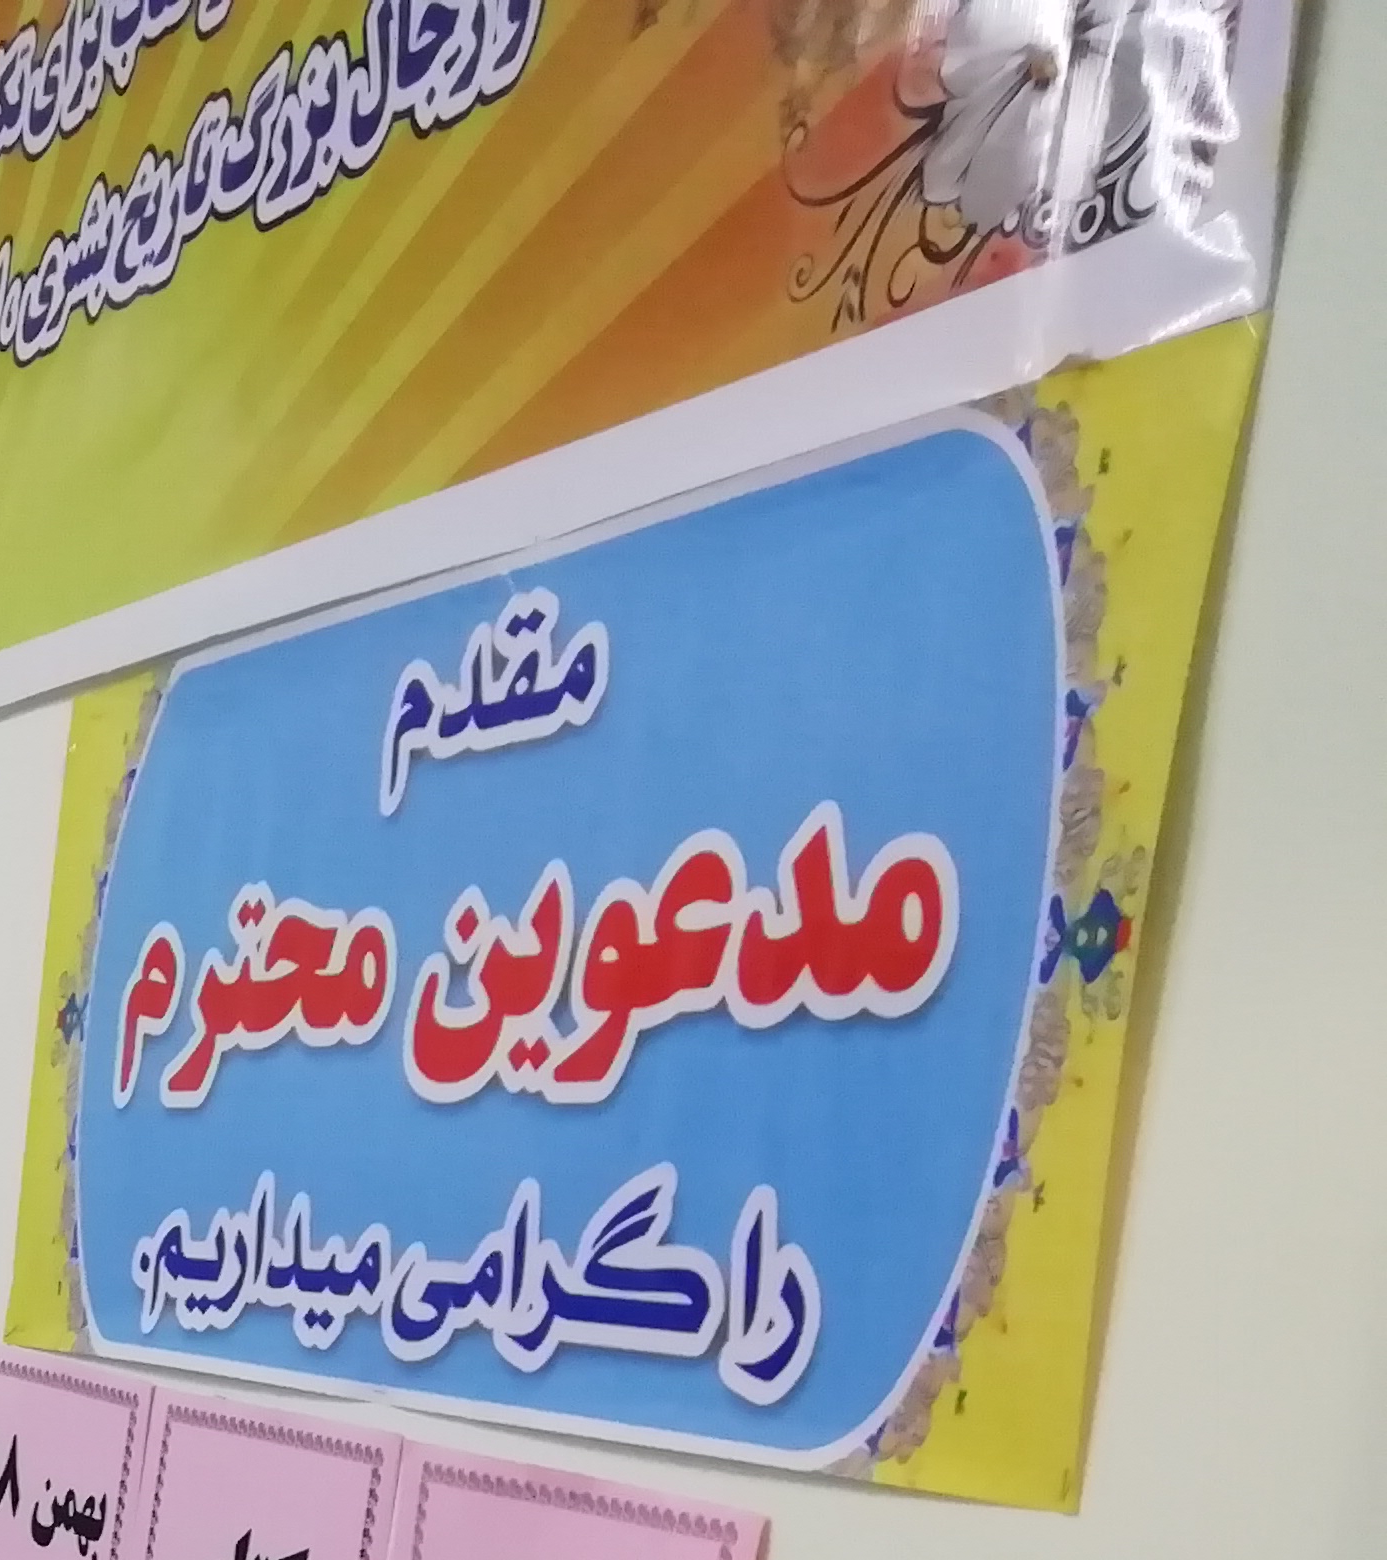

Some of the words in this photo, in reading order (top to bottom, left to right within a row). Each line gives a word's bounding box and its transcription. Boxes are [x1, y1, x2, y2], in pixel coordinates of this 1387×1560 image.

[99, 88, 230, 308] تاریخ
[217, 33, 349, 231] بزرگ
[383, 594, 604, 808] مقدم
[117, 889, 391, 1102] محترم
[408, 811, 952, 1095] مدعوین
[138, 1178, 382, 1336] میداریم.
[389, 1170, 714, 1358] گرامی
[727, 1197, 814, 1392] را
